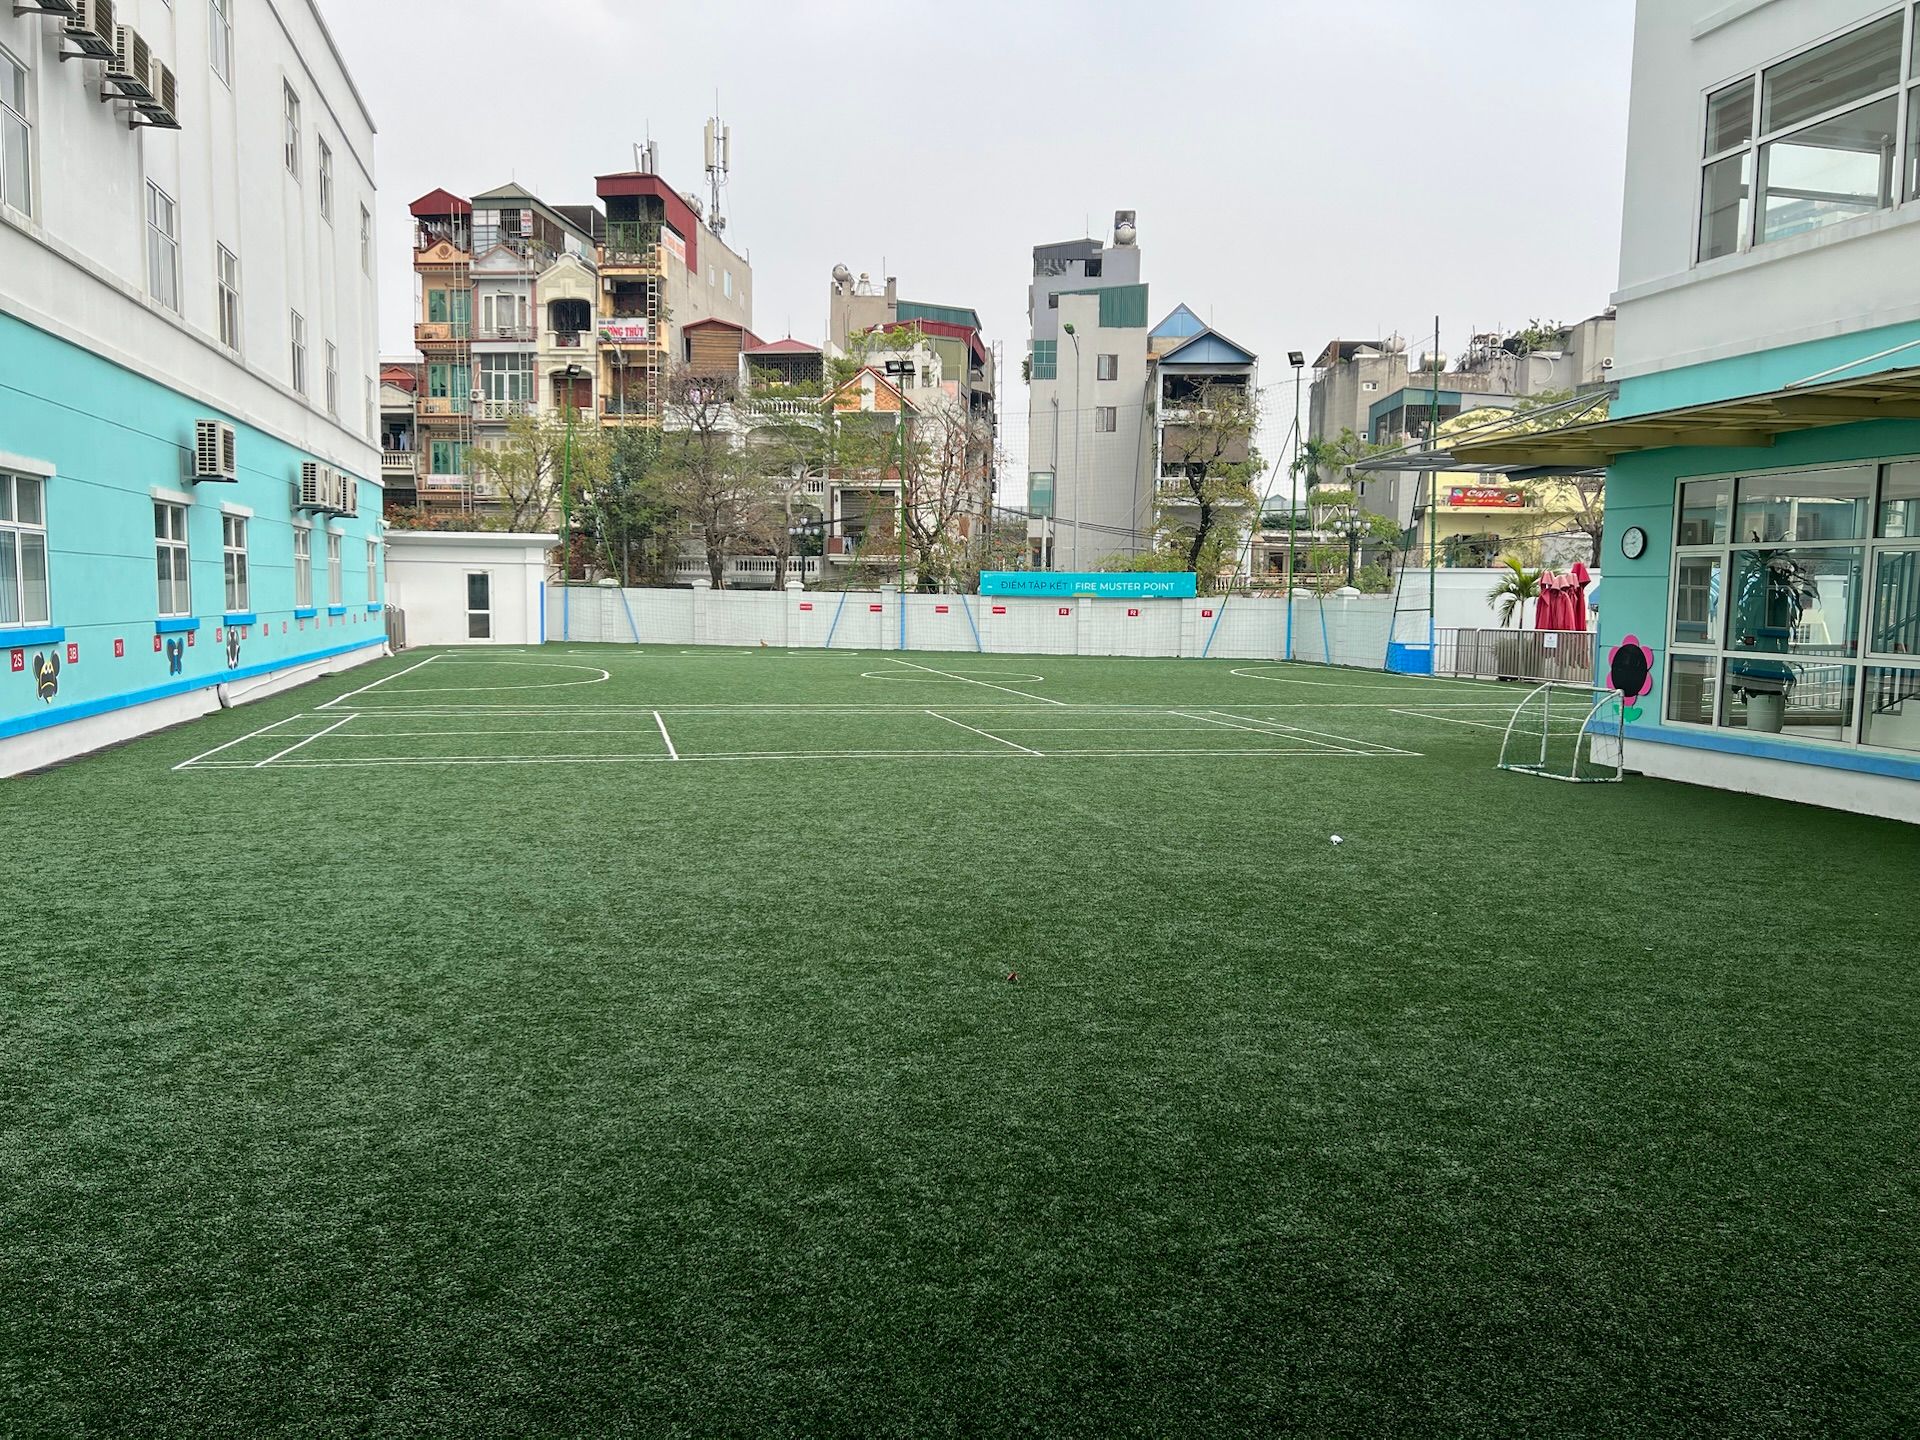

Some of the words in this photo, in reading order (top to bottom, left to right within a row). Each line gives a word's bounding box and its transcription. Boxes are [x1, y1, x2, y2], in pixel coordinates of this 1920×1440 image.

[1075, 582, 1097, 591] FIRE
[1099, 582, 1141, 591] MUSTER
[1143, 582, 1175, 591] POINT
[69, 647, 77, 660] 3B
[13, 653, 23, 668] 2S
